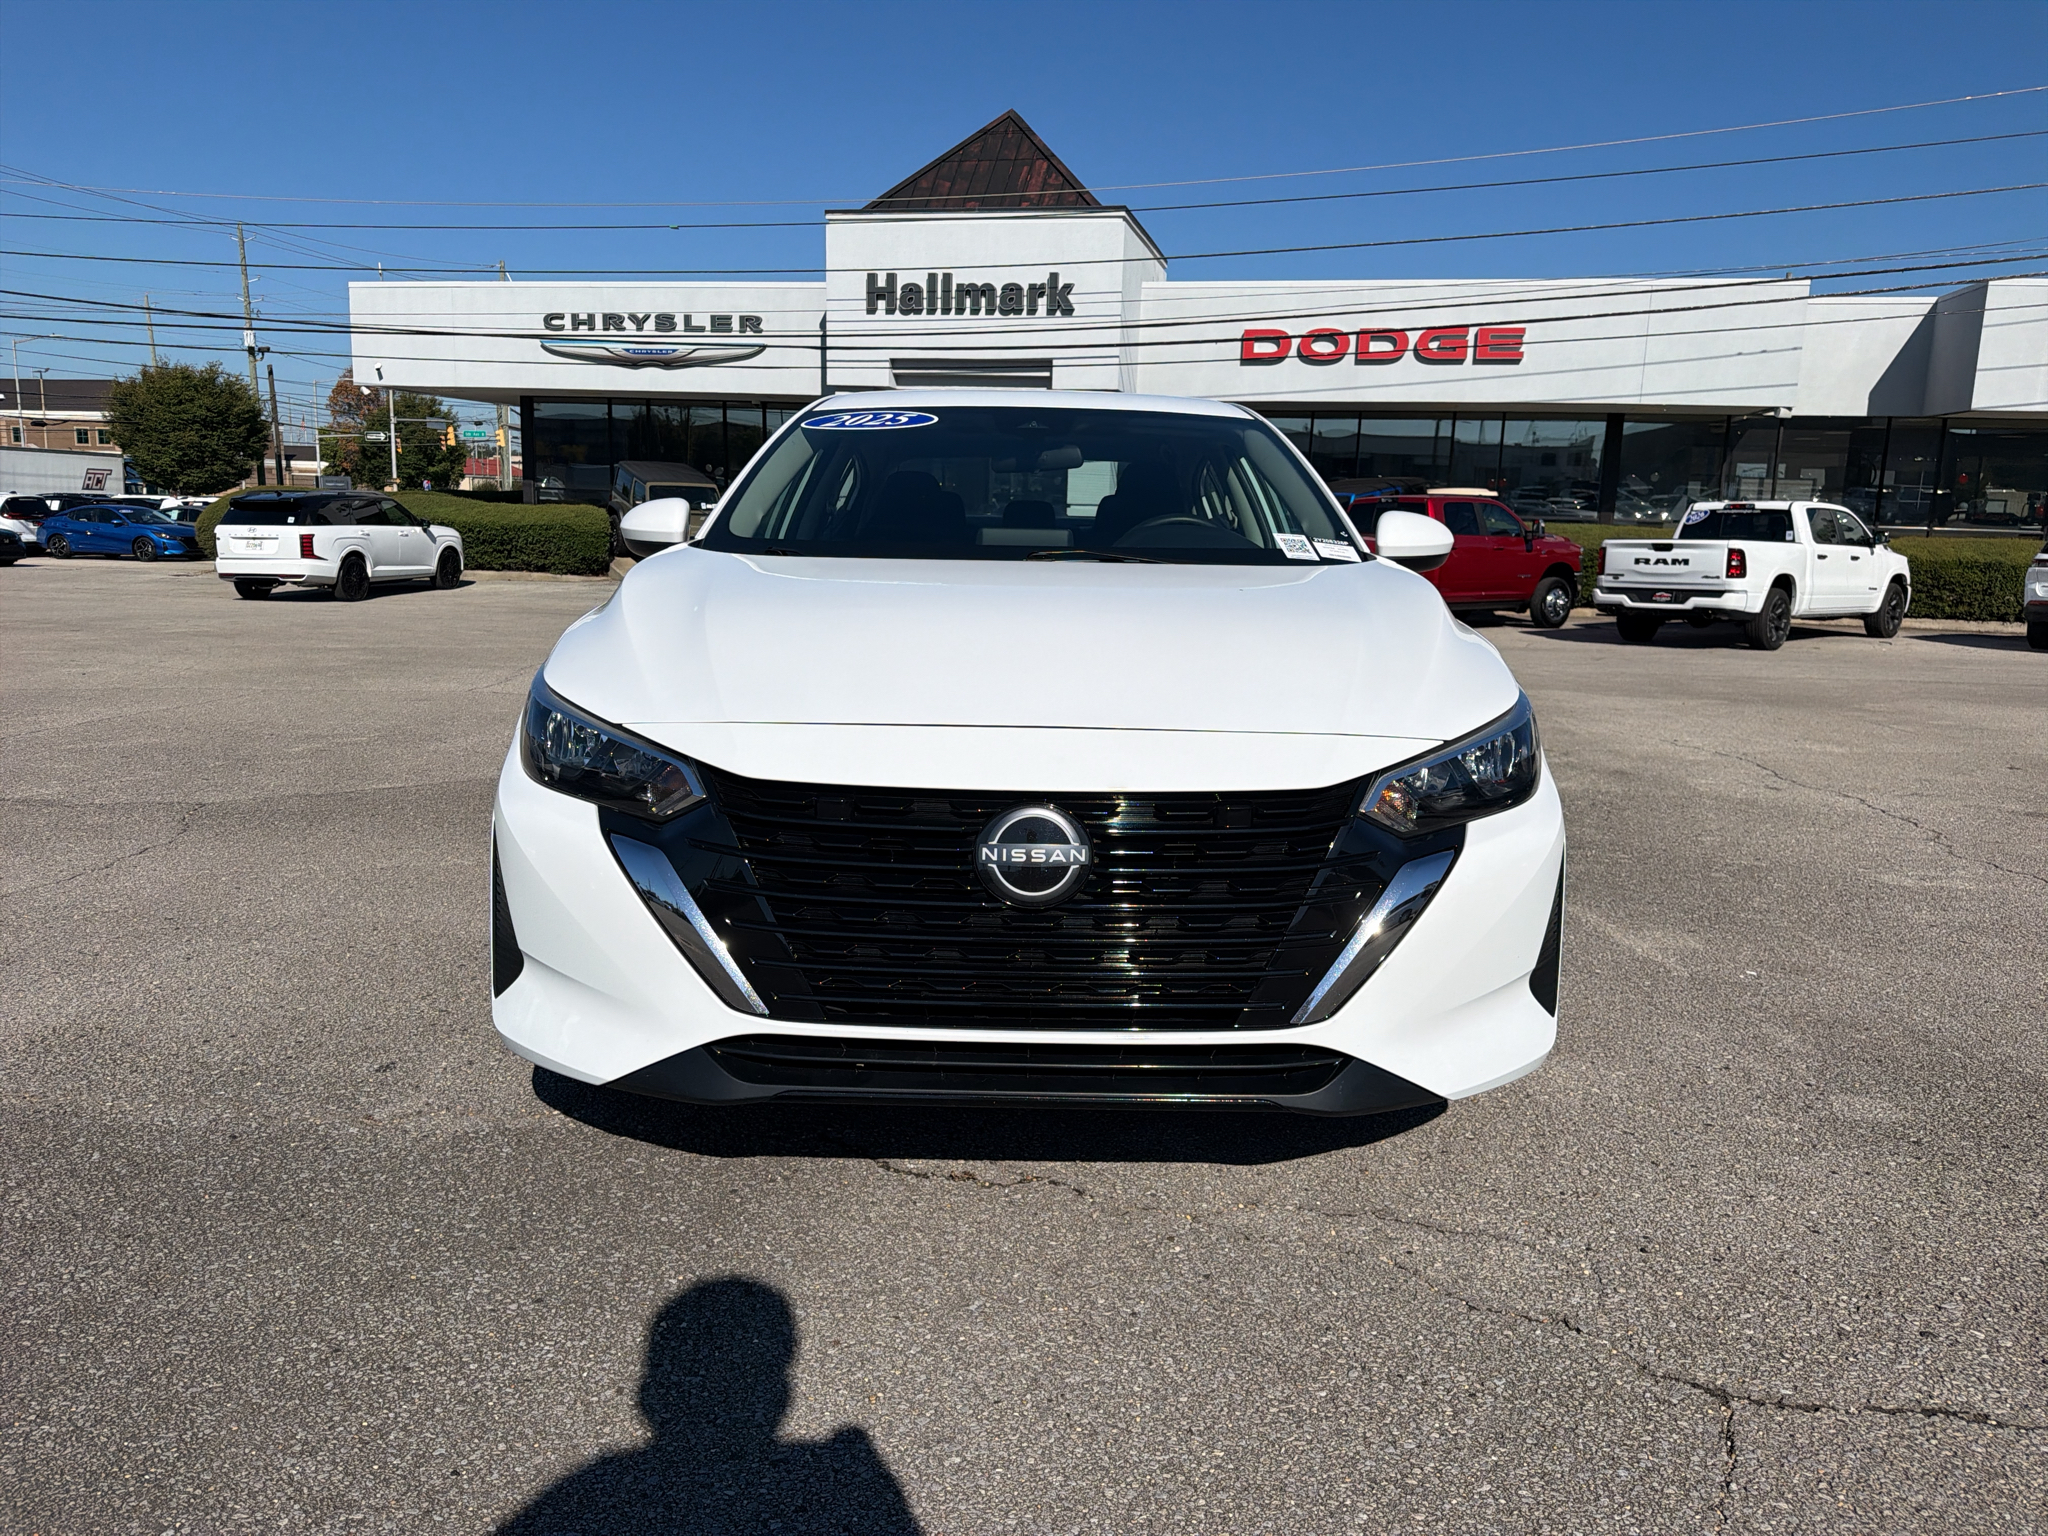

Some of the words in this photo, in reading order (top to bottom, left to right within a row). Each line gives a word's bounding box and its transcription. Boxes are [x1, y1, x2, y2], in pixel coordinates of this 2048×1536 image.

[866, 271, 1075, 317] Hallmark
[543, 312, 764, 334] CHRYSLER
[1240, 327, 1526, 365] DODGE
[819, 413, 919, 427] 2025
[82, 468, 112, 490] ACT
[1634, 557, 1690, 566] RAM
[981, 847, 1086, 863] NISSAN
